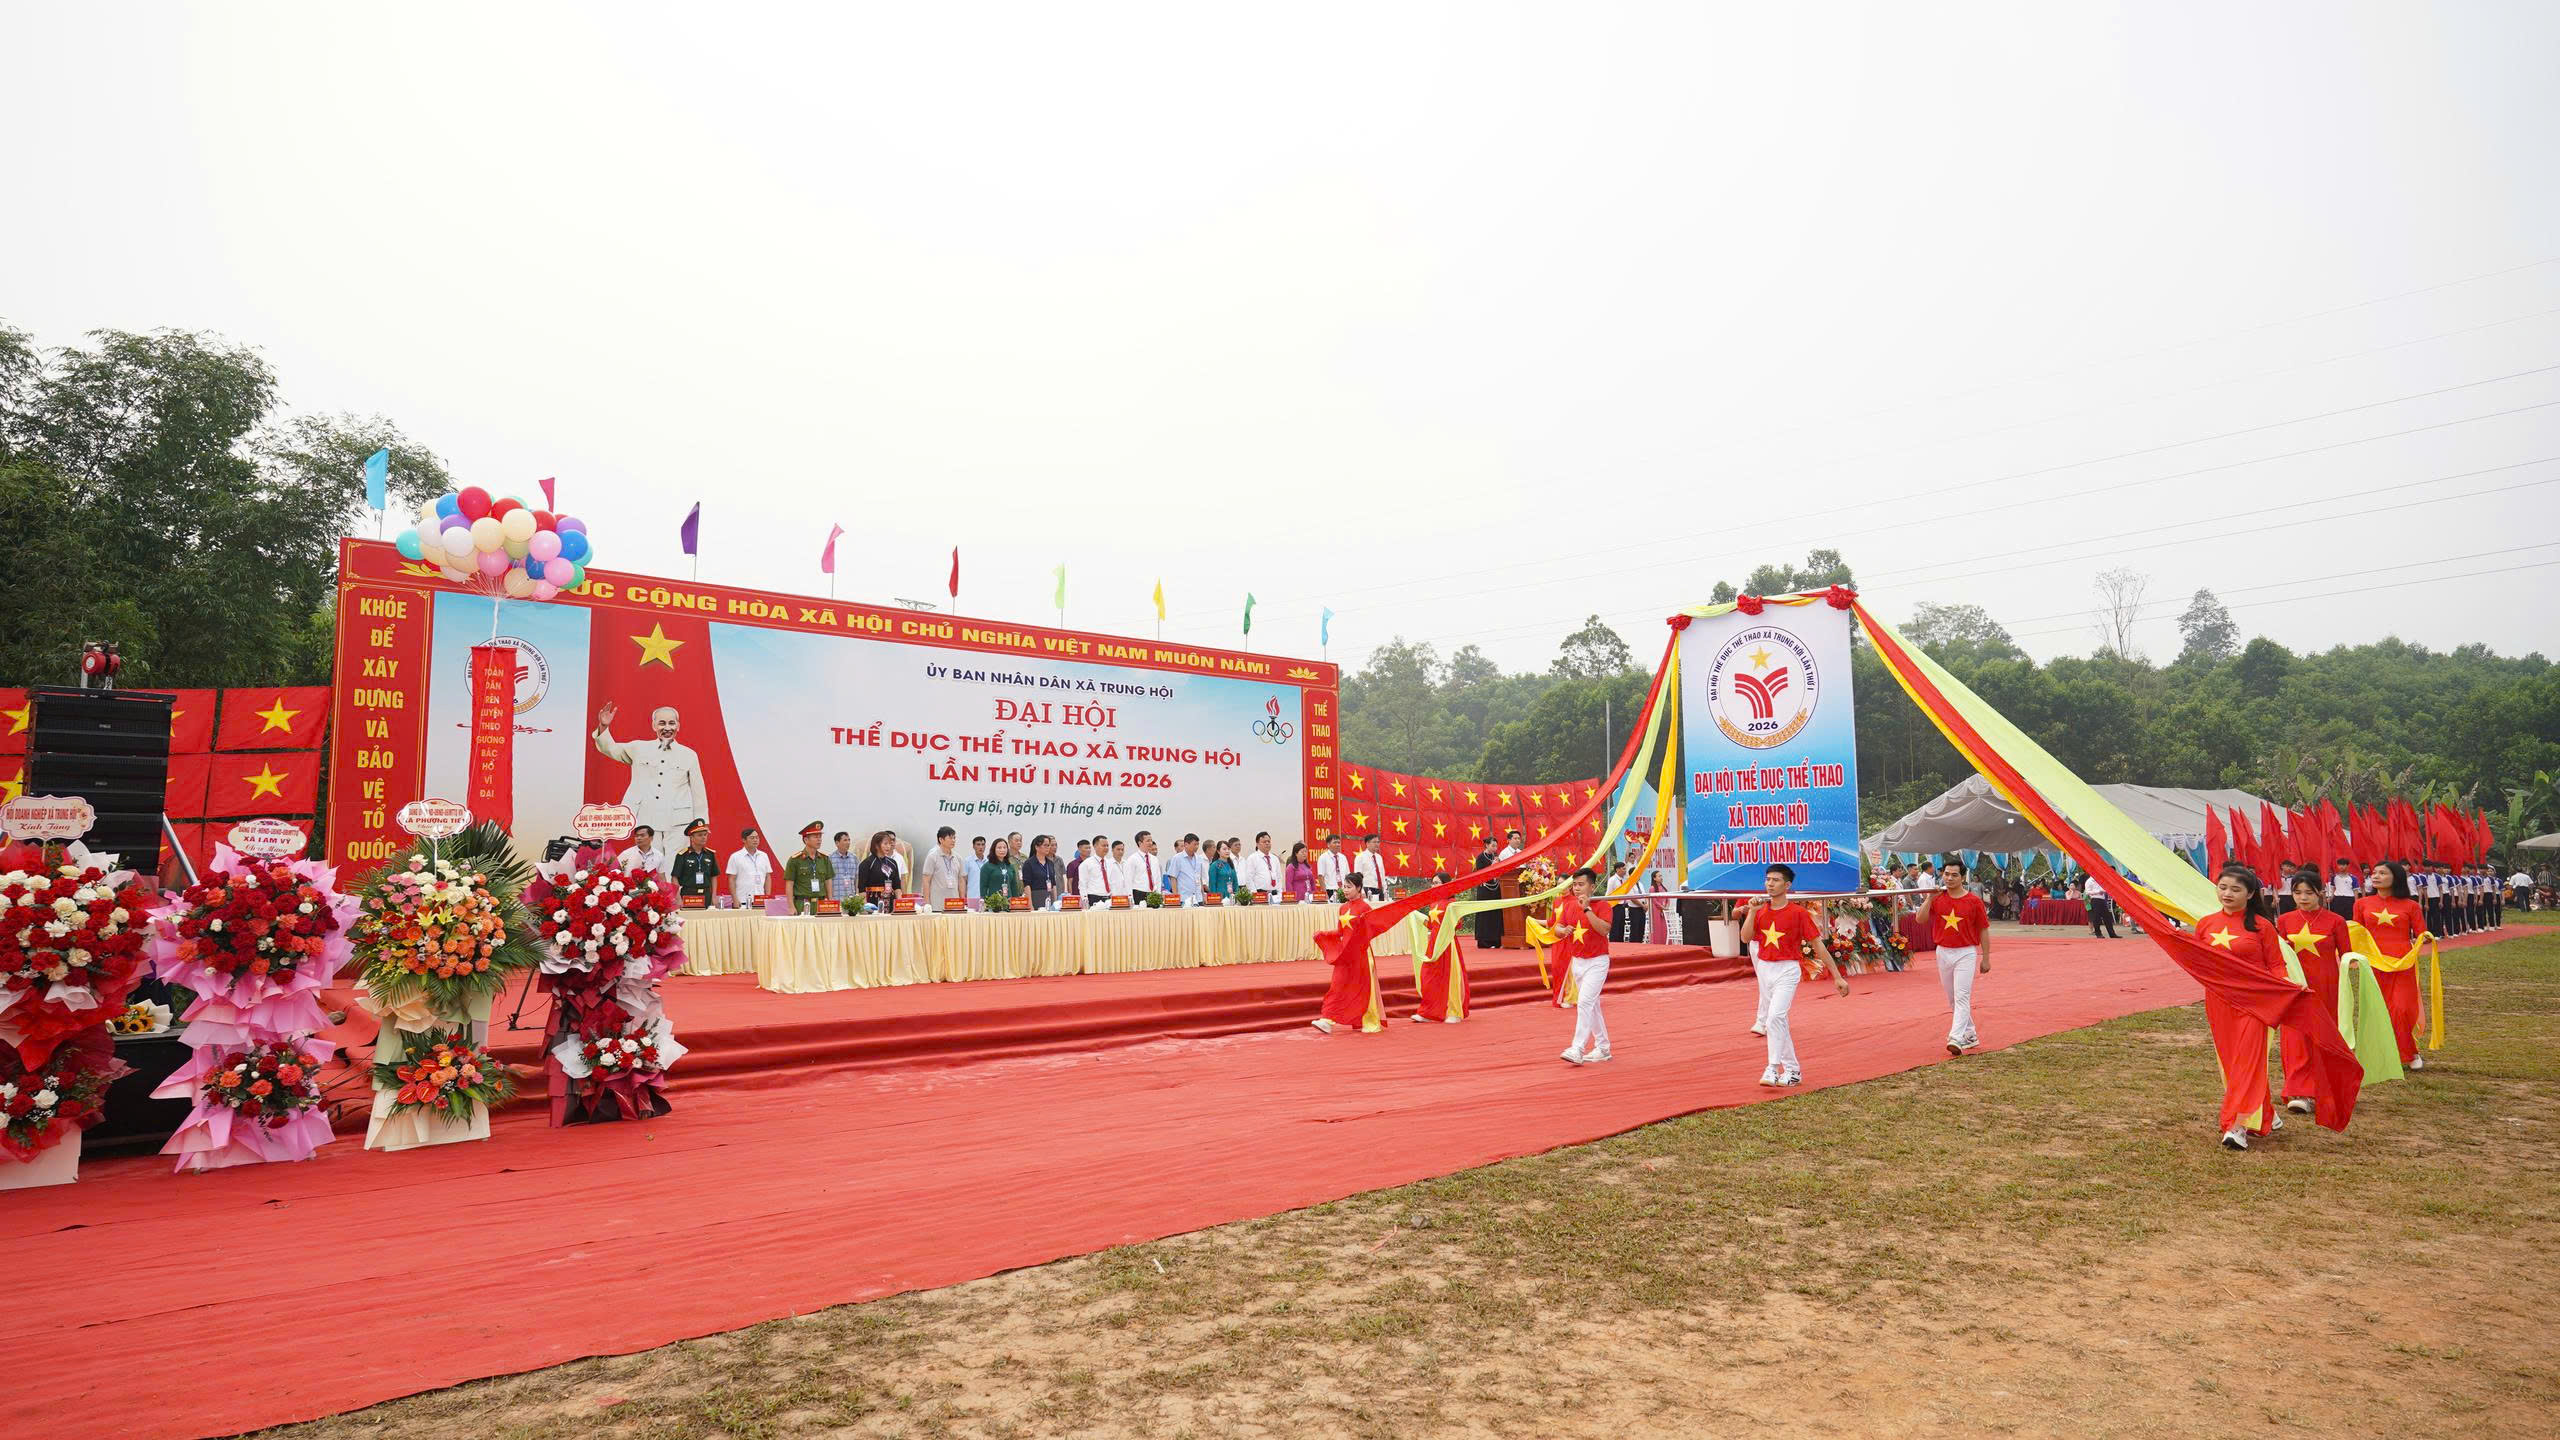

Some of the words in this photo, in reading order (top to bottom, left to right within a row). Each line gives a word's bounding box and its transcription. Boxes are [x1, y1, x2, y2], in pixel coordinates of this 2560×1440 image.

[360, 595, 407, 619] KHỎE
[370, 624, 395, 648] ĐỂ
[626, 586, 717, 612] CỘNG
[728, 597, 790, 620] HÒA
[799, 608, 838, 625] XÃ
[847, 614, 892, 634] HỘI
[902, 621, 954, 639] CHỦ
[962, 628, 1037, 649] NGHĨA
[1043, 637, 1091, 655] VIỆT
[1098, 644, 1148, 661] NAM
[1154, 650, 1215, 668] MUÔN
[1220, 658, 1271, 674] NĂM!
[1744, 631, 1761, 642] THAO
[1774, 632, 1794, 648] TRUNG
[362, 656, 398, 678] XÂY
[927, 662, 947, 678] ỦY
[952, 668, 985, 682] BAN
[990, 672, 1035, 686] NHÂN
[1039, 675, 1071, 690] DÂN
[1075, 678, 1096, 692] XÃ
[1099, 683, 1145, 696] TRUNG
[1149, 685, 1174, 700] HỘI
[353, 688, 404, 711] DỰNG
[1313, 699, 1328, 717] THỂ
[995, 699, 1052, 728] ĐẠI
[1062, 700, 1117, 732] HỘI
[1748, 721, 1778, 732] 2026
[366, 717, 389, 739] VÀ
[1311, 724, 1331, 738] THAO
[357, 745, 394, 769] BẢO
[831, 720, 883, 747] THỂ
[891, 731, 950, 754] DỤC
[959, 729, 1005, 753] THỂ
[1011, 738, 1078, 757] THAO
[1086, 741, 1119, 759] XÃ
[1125, 745, 1198, 763] TRUNG
[1204, 747, 1241, 770] HỘI
[1311, 743, 1332, 758] ĐOÀN
[929, 756, 979, 782] LẦN
[987, 763, 1037, 784] THỨ
[1043, 769, 1049, 784] I
[1058, 767, 1112, 787] NĂM
[1120, 772, 1172, 788] 2026
[1314, 762, 1328, 779] KẾT
[1694, 773, 1712, 797] ĐẠI
[1716, 768, 1734, 797] HỘI
[1737, 761, 1757, 791] THỂ
[1760, 768, 1784, 794] DỤC
[1787, 757, 1809, 788] THỂ
[1812, 764, 1843, 787] THAO
[363, 778, 385, 803] VỆ
[1310, 786, 1334, 800] TRUNG
[363, 804, 386, 829] TỔ
[939, 800, 974, 816] Trung
[978, 800, 1003, 817] Hội,
[1007, 802, 1038, 817] ngày
[1043, 802, 1055, 814] 11
[1059, 802, 1094, 818] tháng
[1097, 804, 1105, 815] 4
[1107, 803, 1132, 816] năm
[1135, 804, 1162, 816] 2026
[1312, 807, 1332, 823] THỰC
[1728, 802, 1745, 827] XÃ
[1746, 804, 1785, 827] TRUNG
[1788, 799, 1809, 830] HỘI
[347, 835, 397, 861] QUỐC
[1712, 835, 1735, 864] LẦN
[1737, 837, 1760, 864] THỨ
[1762, 843, 1766, 863] I
[1769, 837, 1797, 863] NĂM
[1800, 841, 1829, 863] 2026
